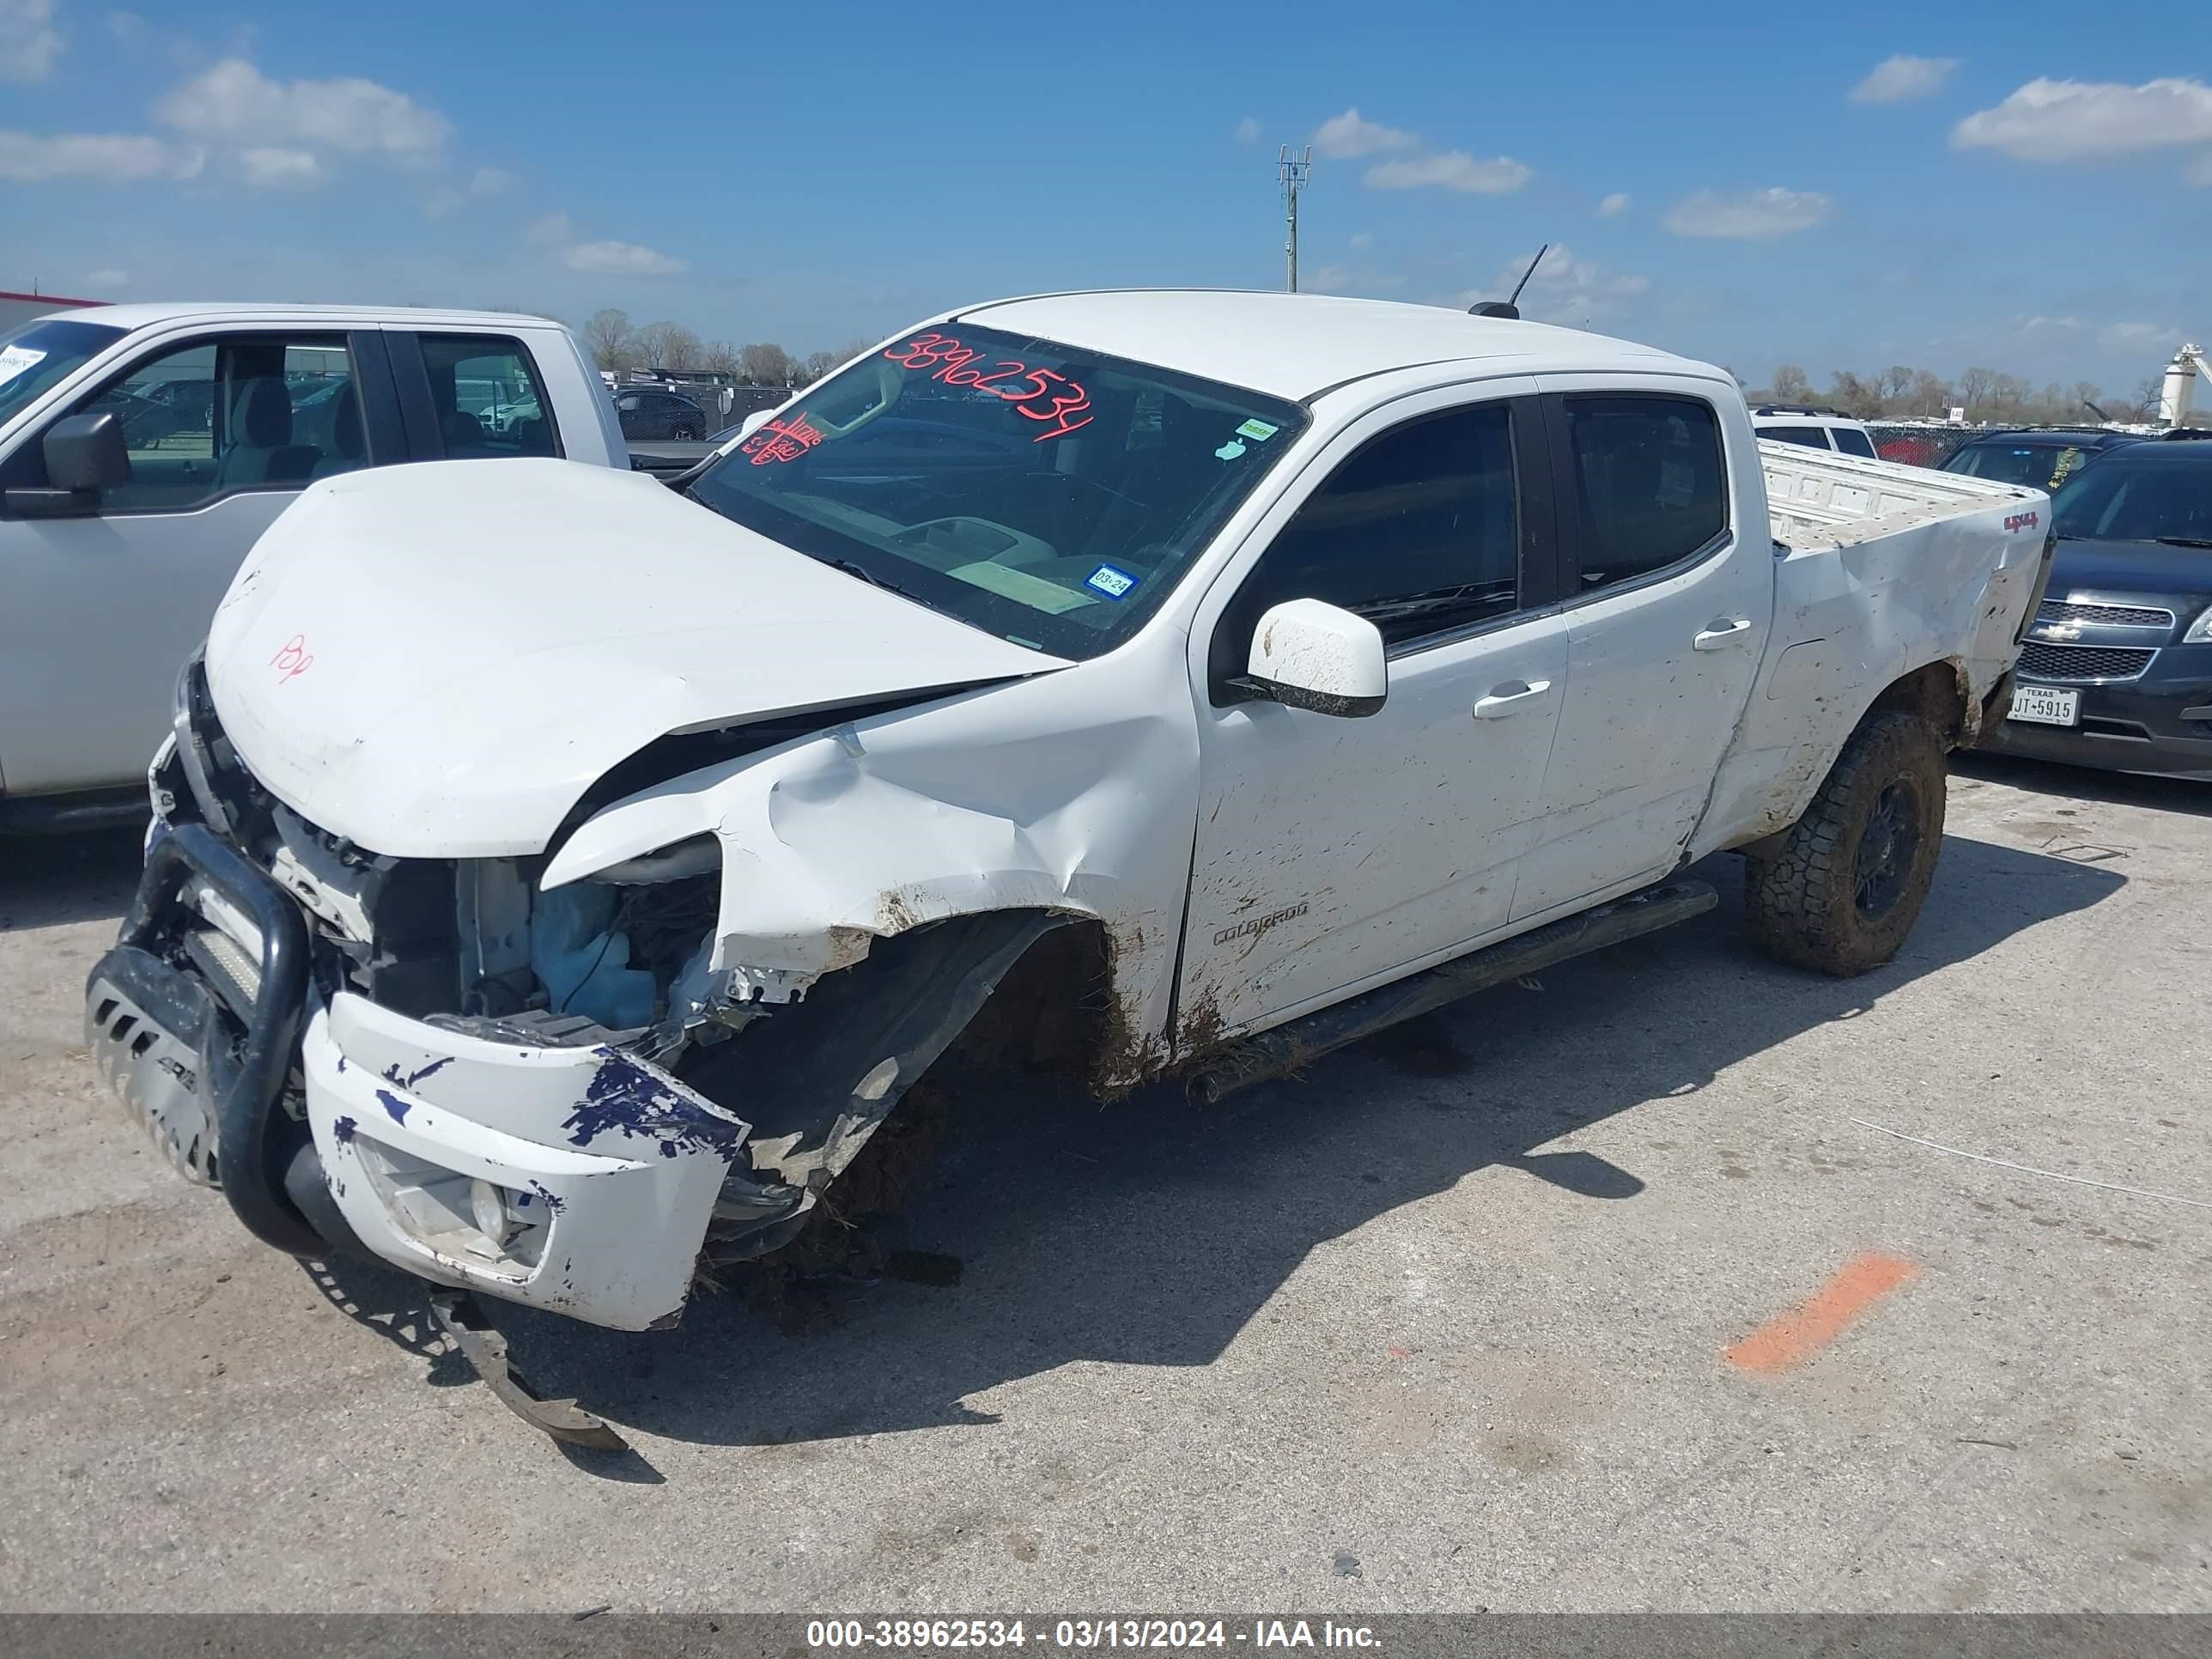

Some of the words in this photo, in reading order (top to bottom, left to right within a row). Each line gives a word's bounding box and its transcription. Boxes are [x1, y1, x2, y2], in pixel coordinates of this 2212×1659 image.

[884, 333, 1095, 443] 38962534
[2027, 689, 2053, 698] TEXAS
[1213, 902, 1309, 945] COLORADO
